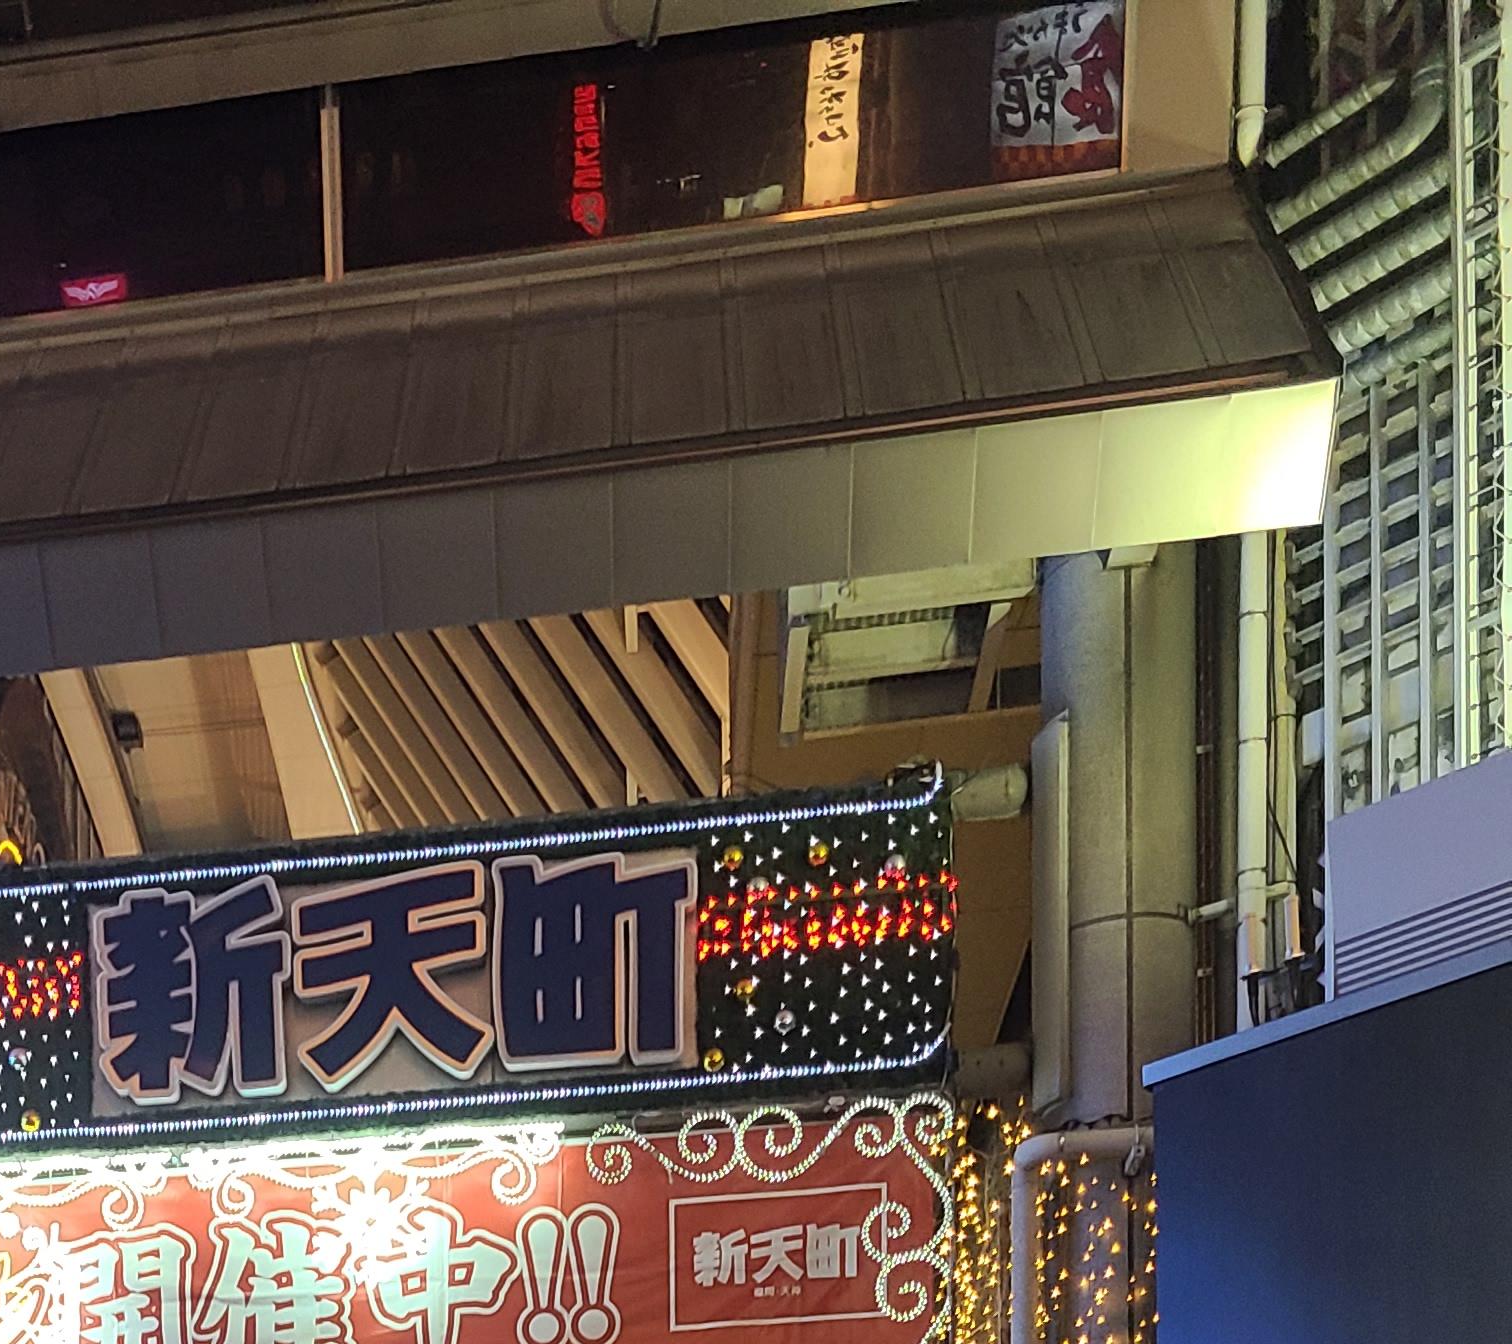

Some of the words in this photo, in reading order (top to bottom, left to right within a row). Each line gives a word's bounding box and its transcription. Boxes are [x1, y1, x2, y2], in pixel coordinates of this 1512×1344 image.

[93, 850, 698, 1105] 新天町
[693, 1223, 861, 1286] 新天町
